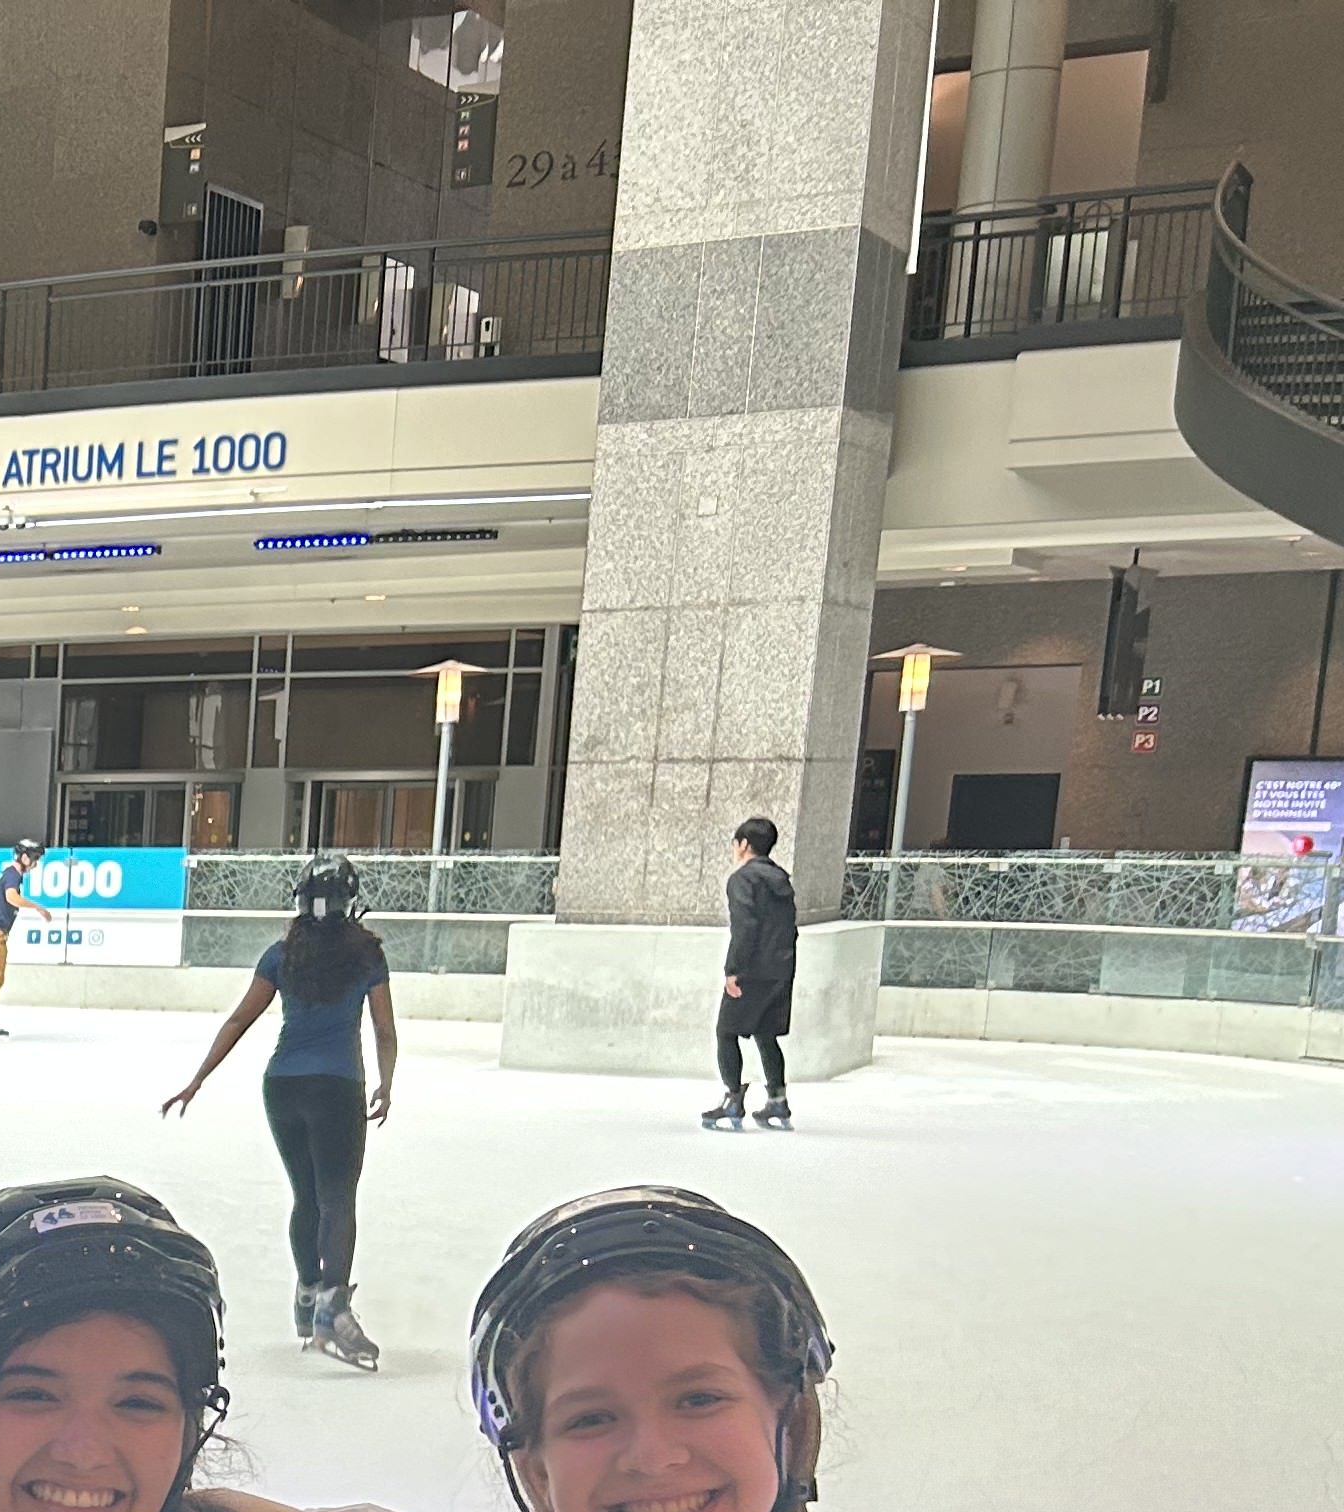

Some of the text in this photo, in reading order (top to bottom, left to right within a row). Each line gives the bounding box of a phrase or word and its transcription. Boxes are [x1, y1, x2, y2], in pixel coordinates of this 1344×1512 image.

[506, 150, 554, 189] 29
[2, 441, 125, 487] ATRIUM
[136, 438, 179, 479] LE
[191, 431, 288, 476] 1000
[1141, 679, 1161, 695] P1
[1137, 706, 1159, 721] P2
[1134, 733, 1156, 749] P3
